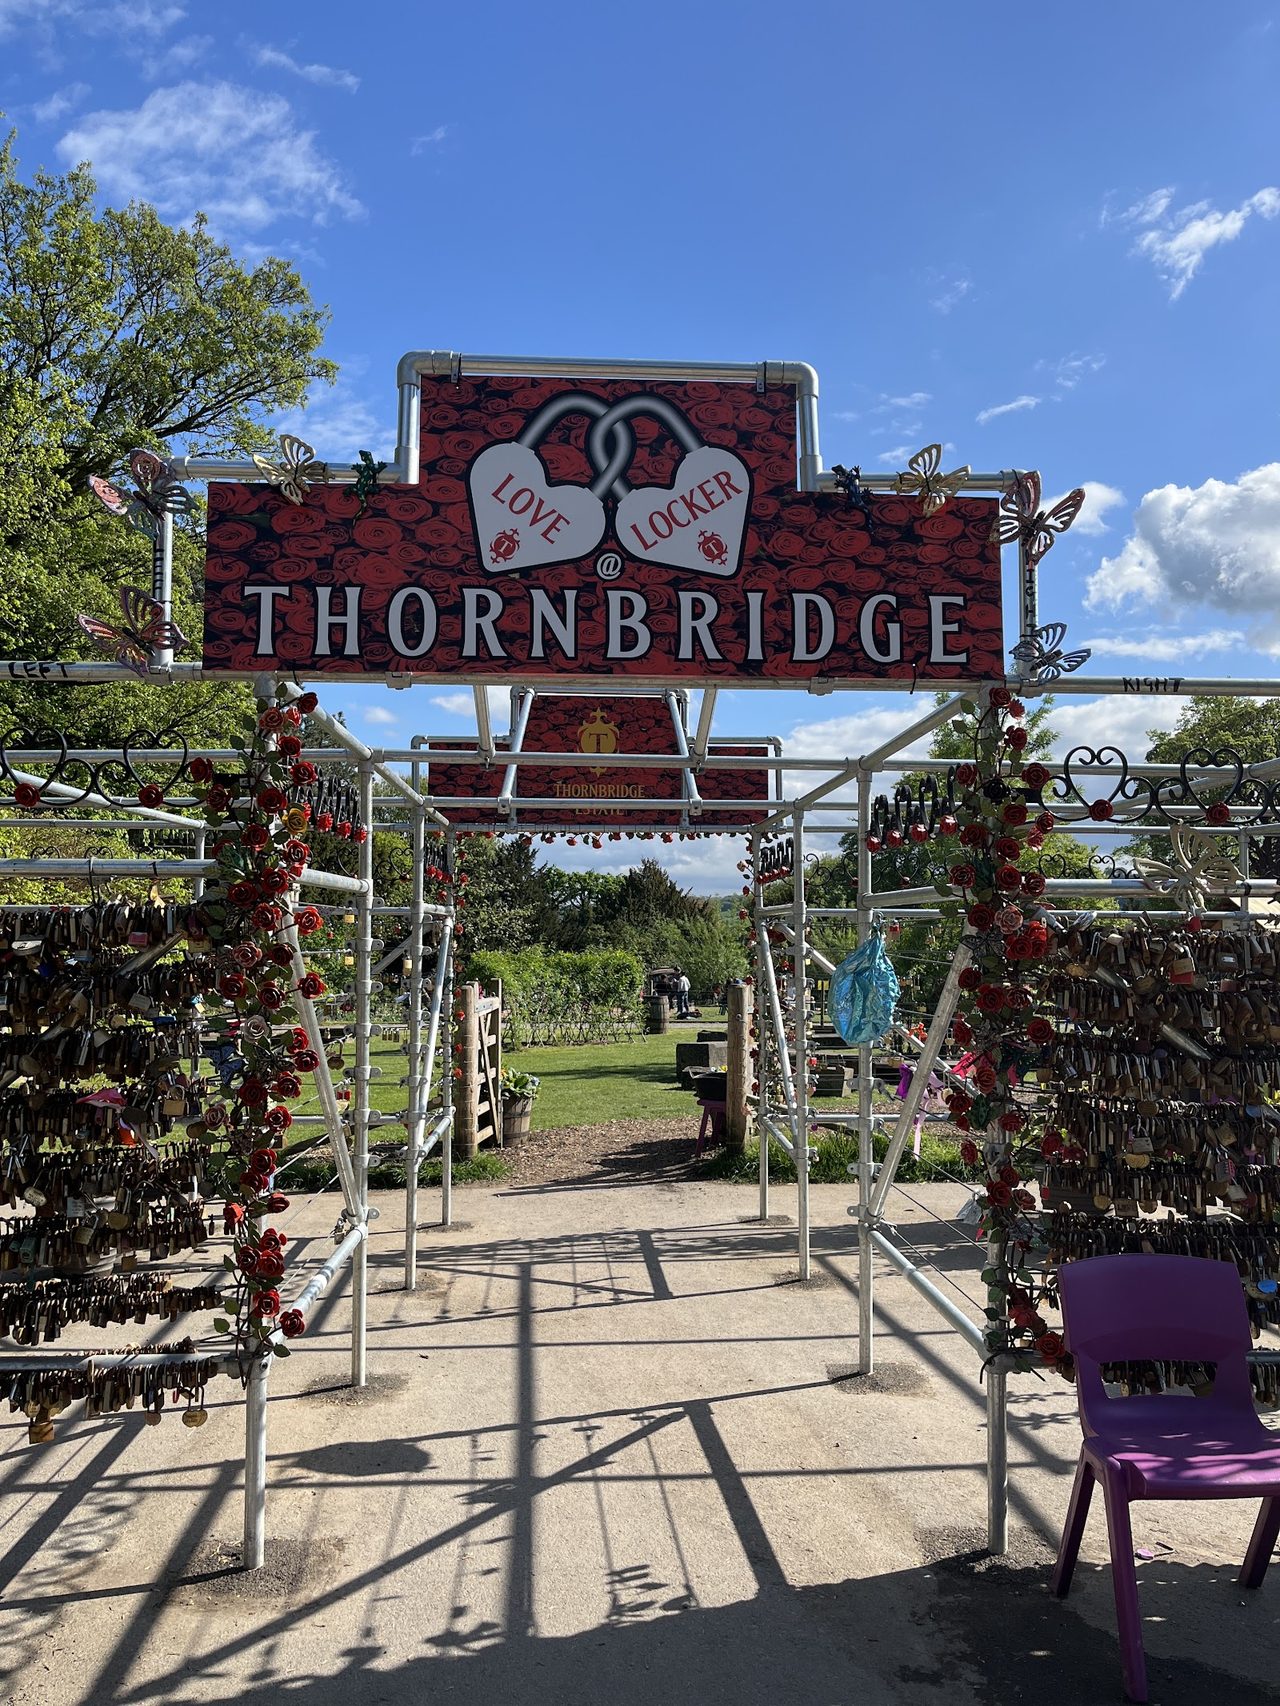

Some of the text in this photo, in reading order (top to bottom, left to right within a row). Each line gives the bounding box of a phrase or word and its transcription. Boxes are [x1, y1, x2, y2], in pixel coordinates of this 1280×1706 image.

[491, 473, 571, 545] LOVE
[630, 471, 744, 551] LOCKER
[596, 553, 622, 580] @
[244, 586, 968, 664] THORNBRIDGE
[8, 661, 77, 680] LEFT
[554, 784, 646, 798] THORNBRIDGE
